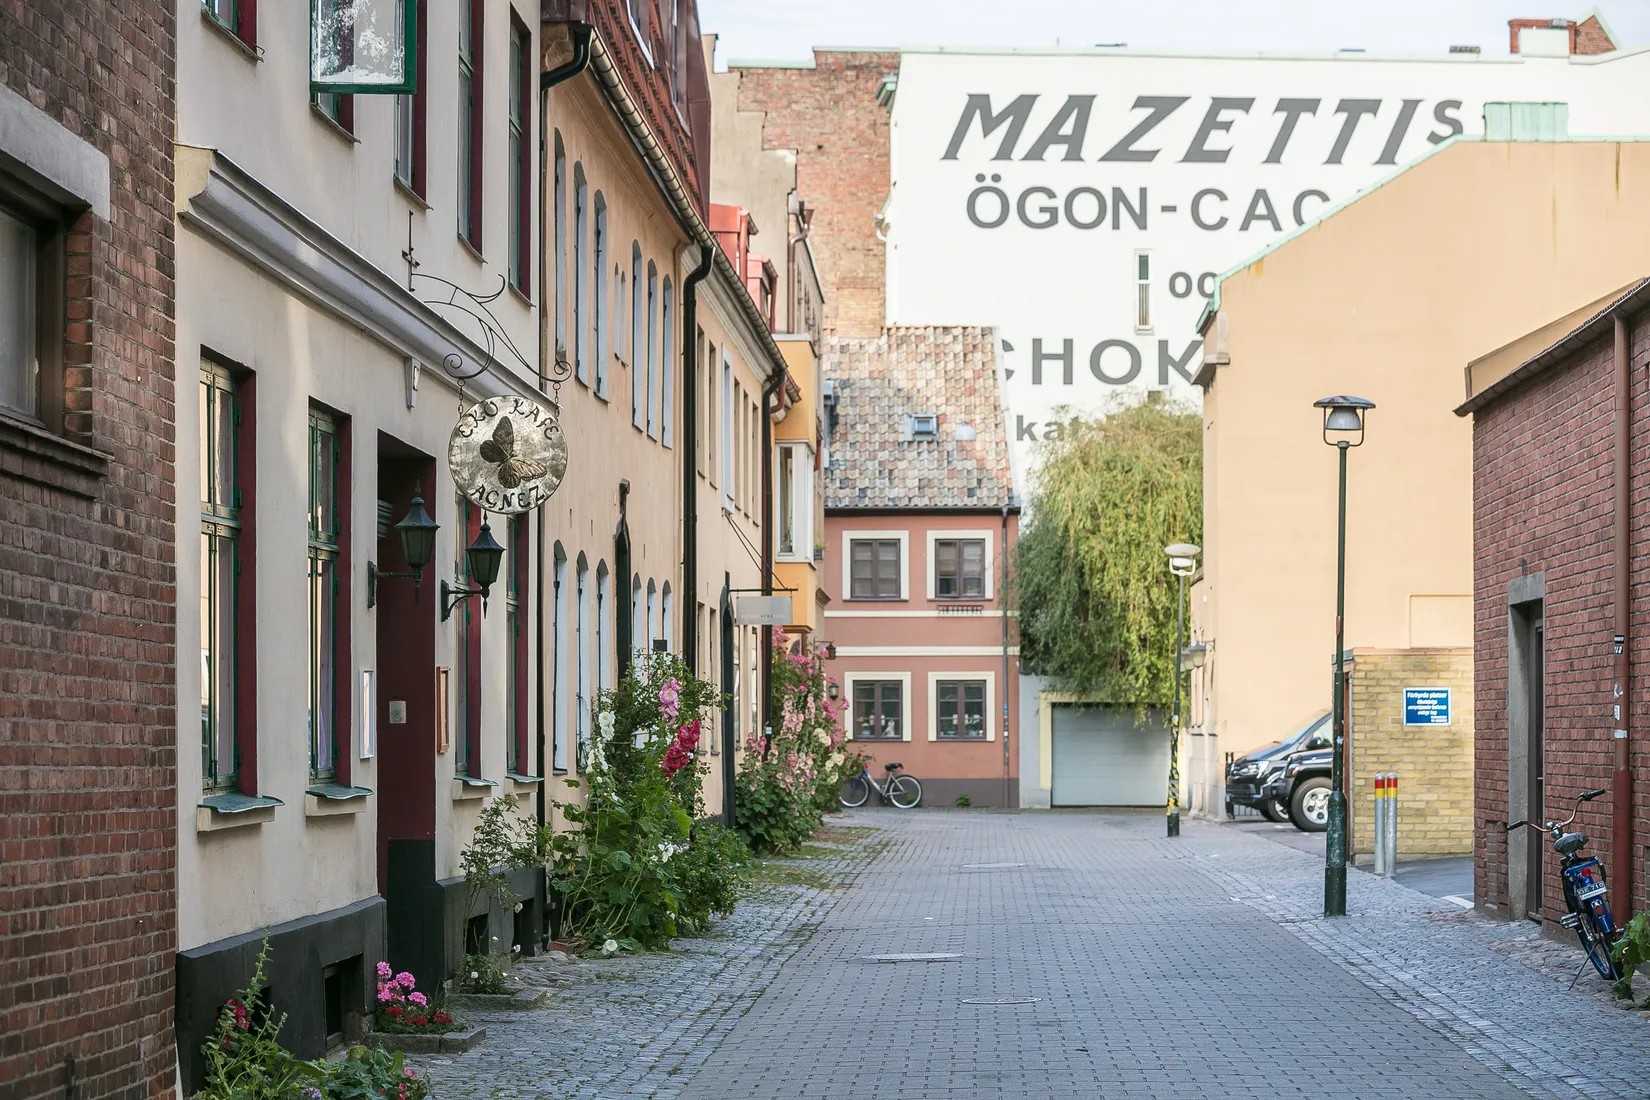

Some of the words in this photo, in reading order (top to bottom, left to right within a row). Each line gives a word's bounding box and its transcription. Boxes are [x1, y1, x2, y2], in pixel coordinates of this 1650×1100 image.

[940, 94, 1463, 165] MAZETTIS
[1001, 338, 1203, 386] HOK
[458, 401, 498, 438] EKO
[470, 484, 545, 511] AGNEZ
